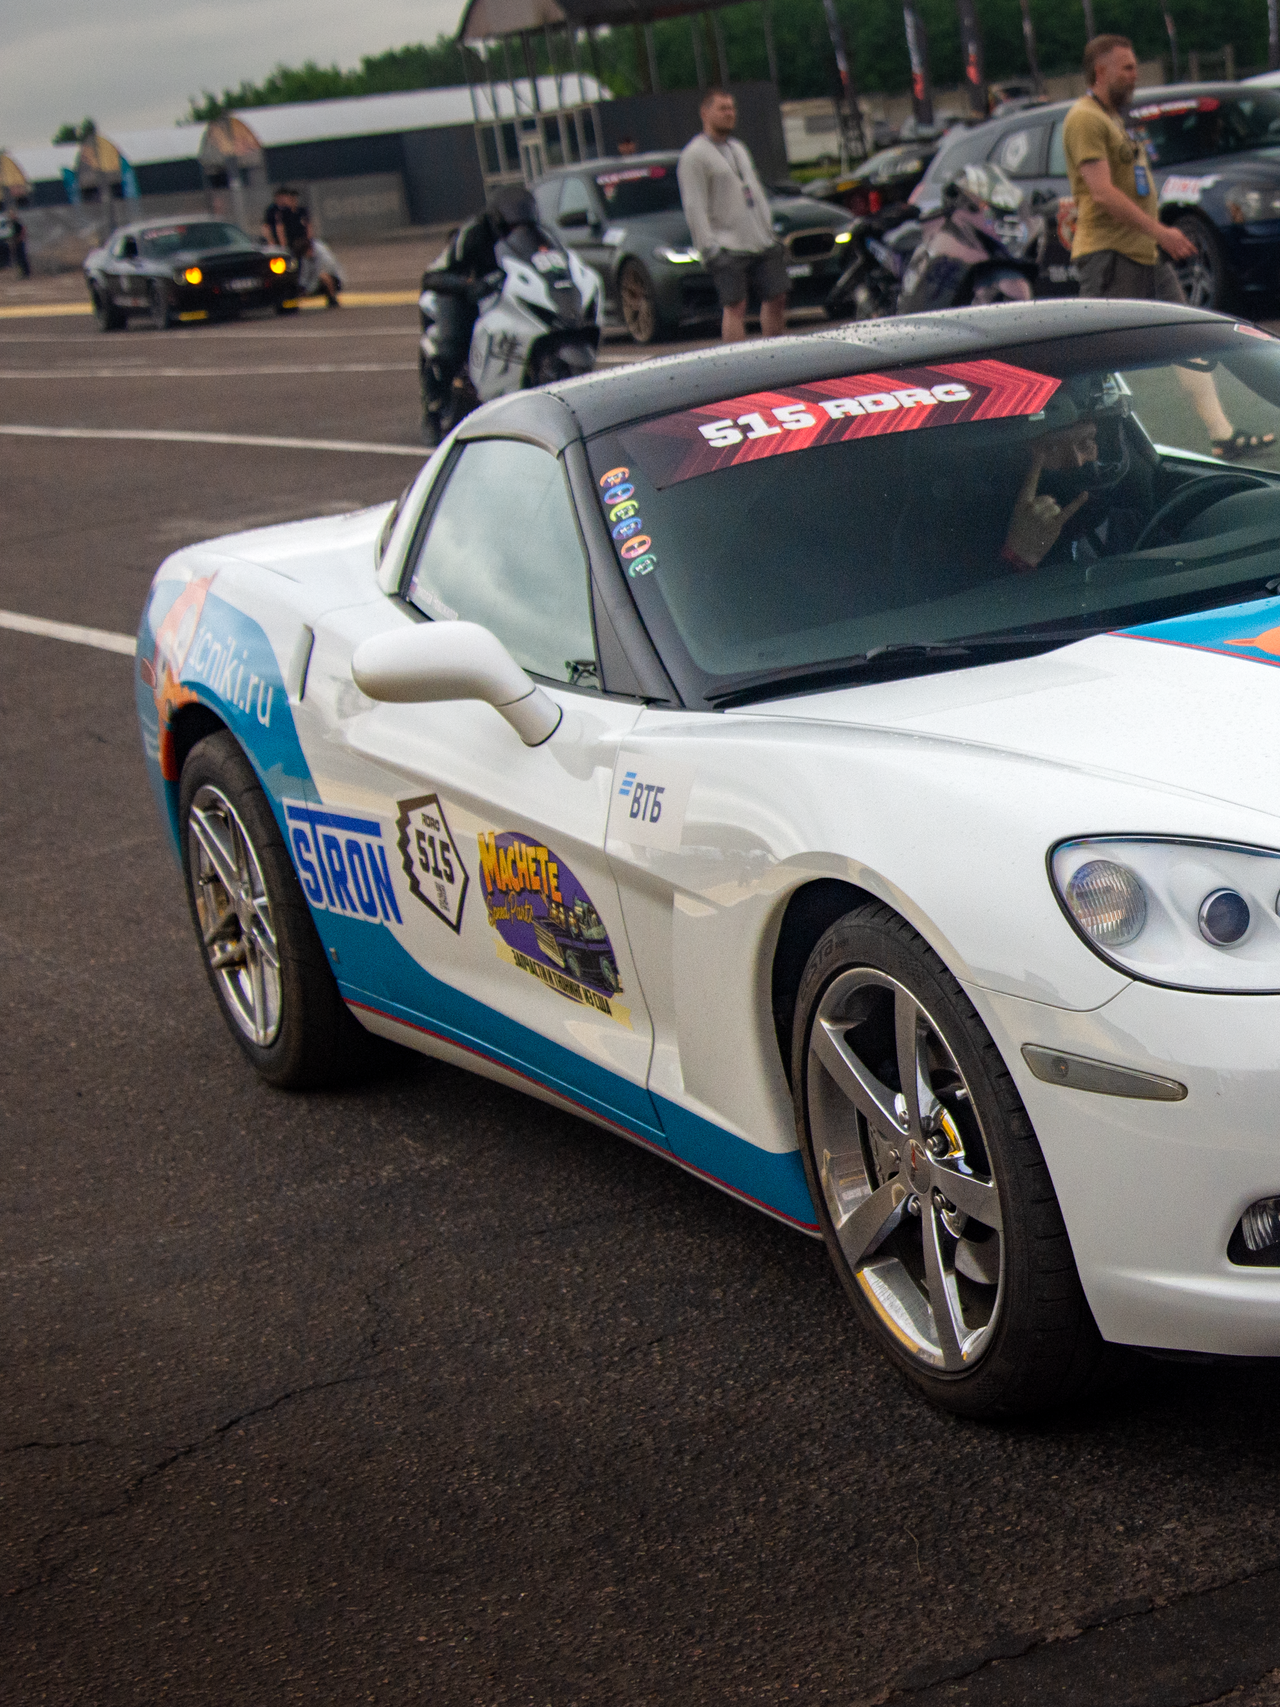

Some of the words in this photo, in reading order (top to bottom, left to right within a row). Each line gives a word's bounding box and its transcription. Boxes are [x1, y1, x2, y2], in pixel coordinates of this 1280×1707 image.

[698, 403, 816, 448] 515
[818, 382, 972, 419] RDRC
[629, 782, 665, 823] ВТБ
[414, 828, 455, 885] 515
[477, 831, 563, 903] MACHETE
